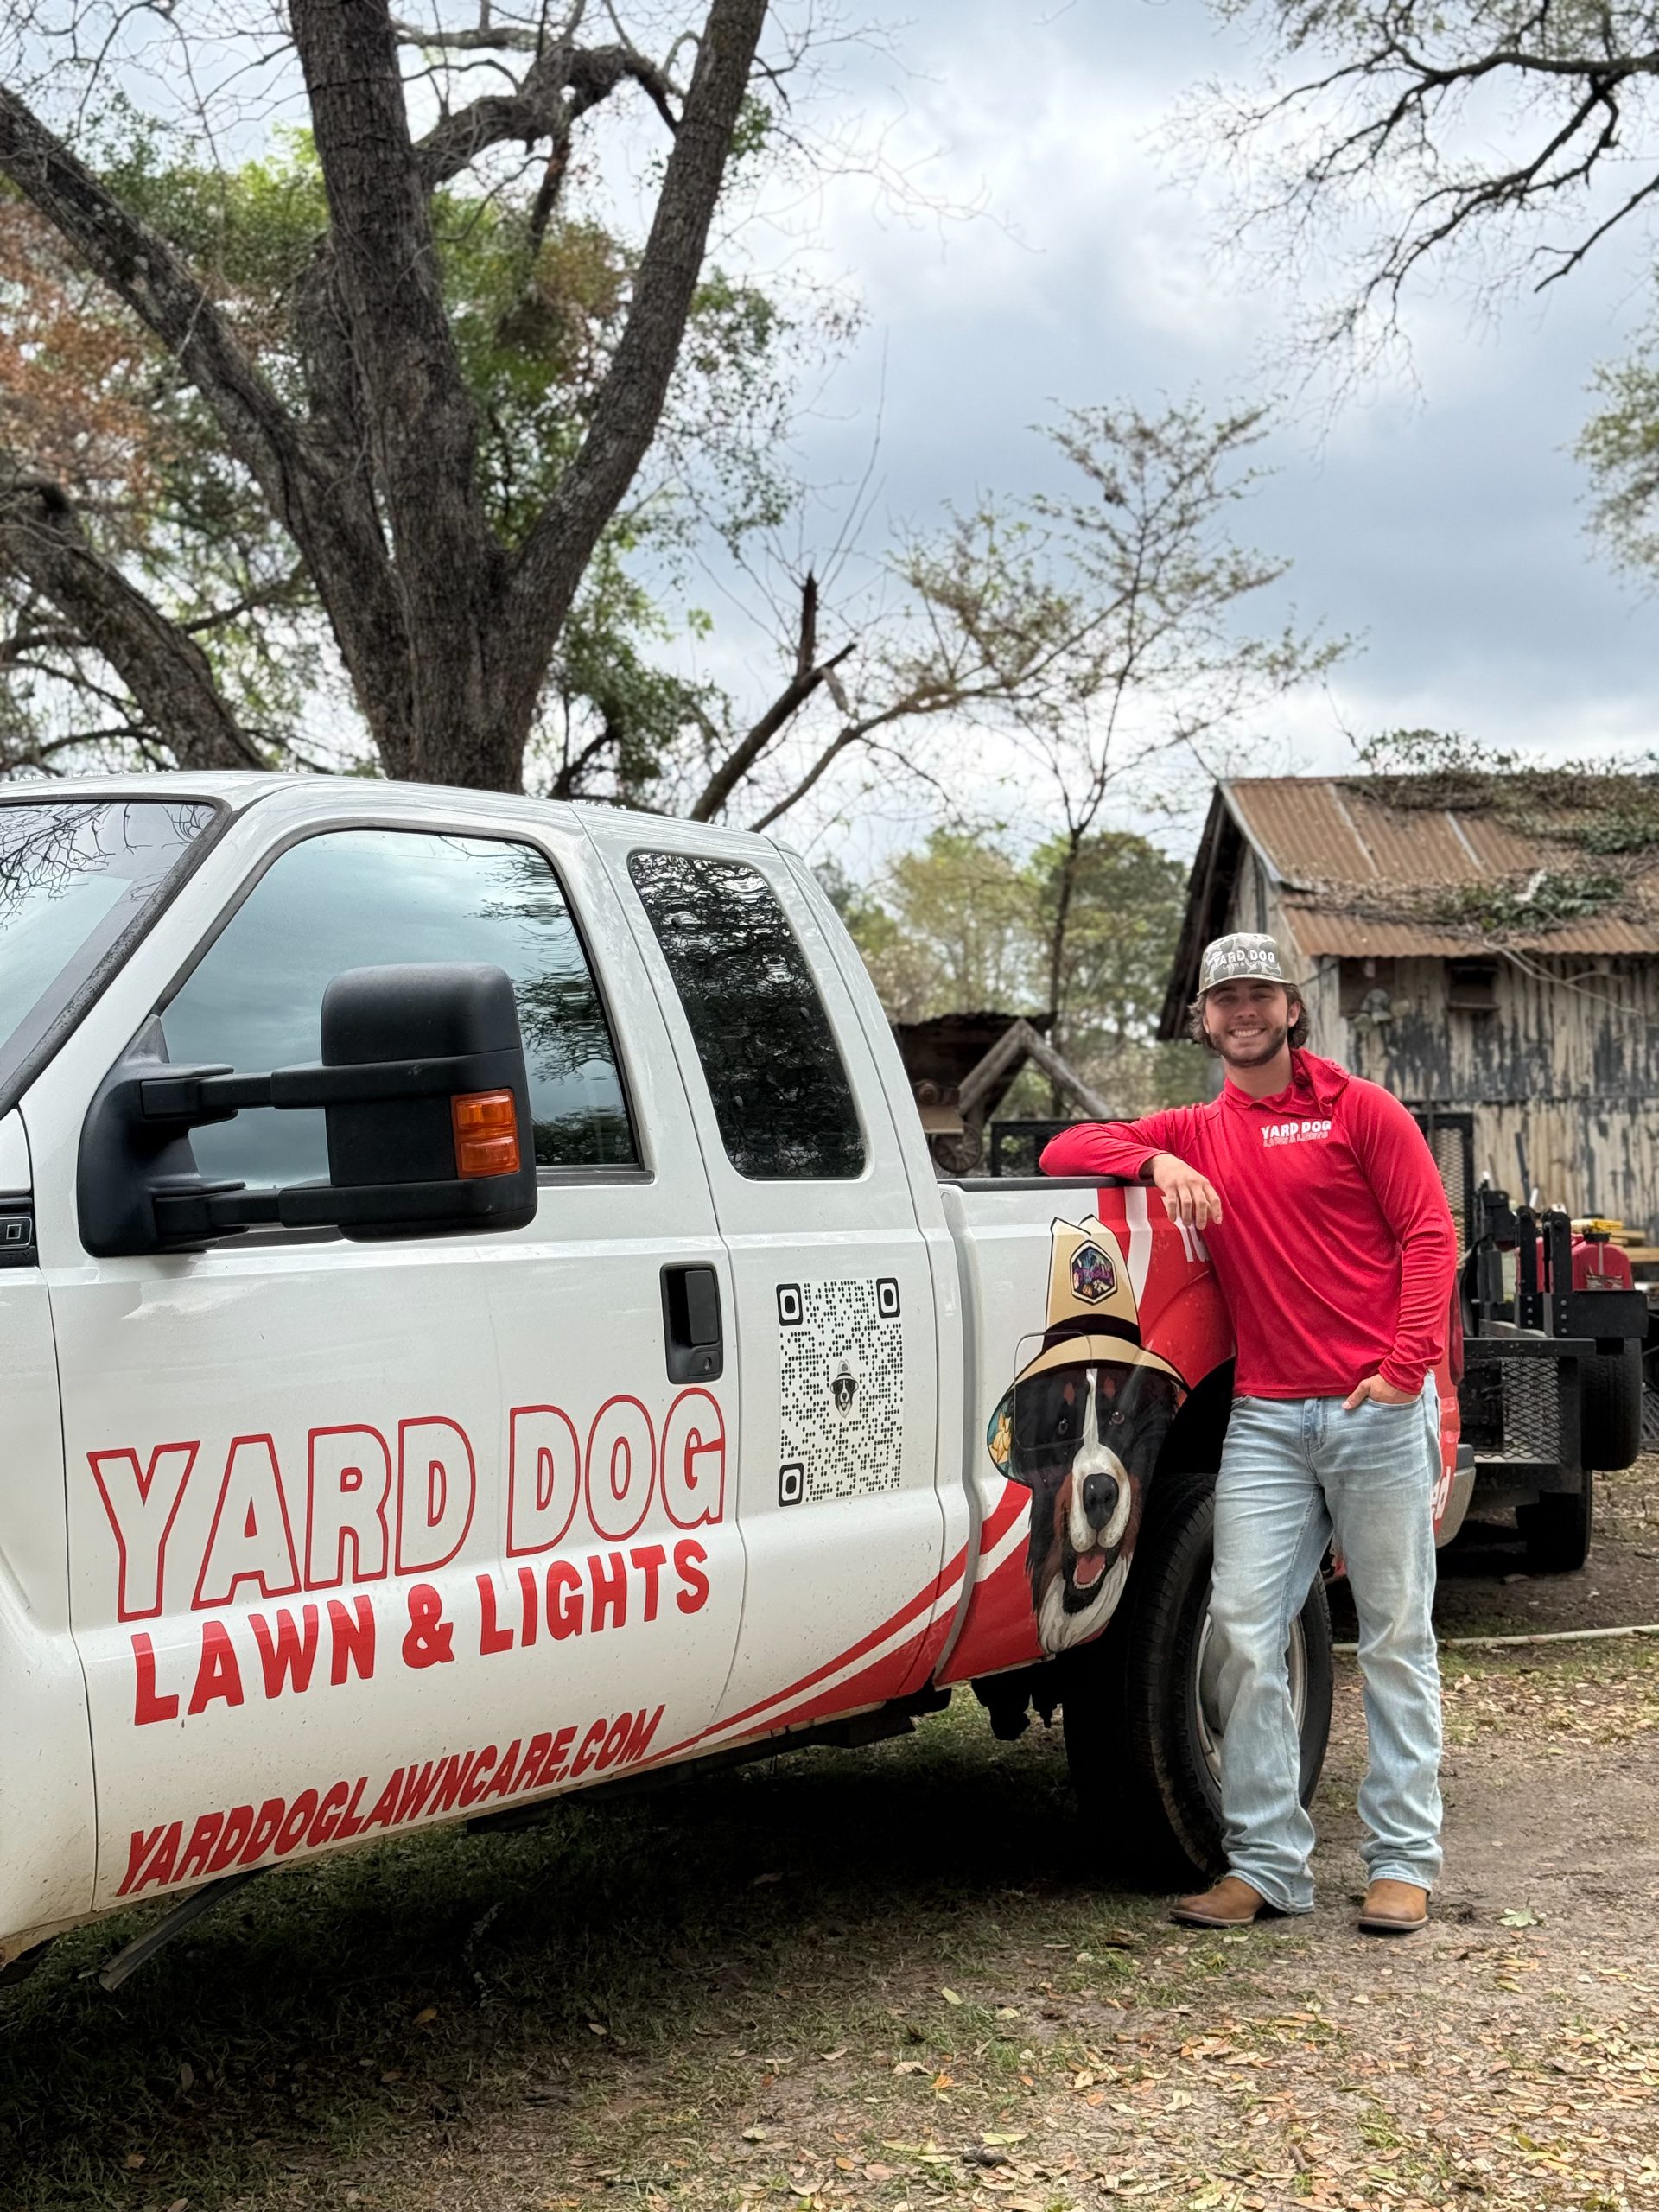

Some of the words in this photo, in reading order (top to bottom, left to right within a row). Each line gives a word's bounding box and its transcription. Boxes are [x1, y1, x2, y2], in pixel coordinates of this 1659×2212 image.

[1211, 950, 1246, 967] YARD
[1249, 950, 1275, 963] DOG
[1260, 1122, 1299, 1140] YARD
[1301, 1120, 1332, 1134] DOG
[87, 1414, 477, 1624] YARD
[505, 1386, 727, 1559] DOG
[132, 1595, 377, 1726] LAWN
[402, 1583, 455, 1669] &
[476, 1538, 710, 1656] LIGHTS
[115, 1704, 666, 1897] YARDDOGLAWNCARE.COM
